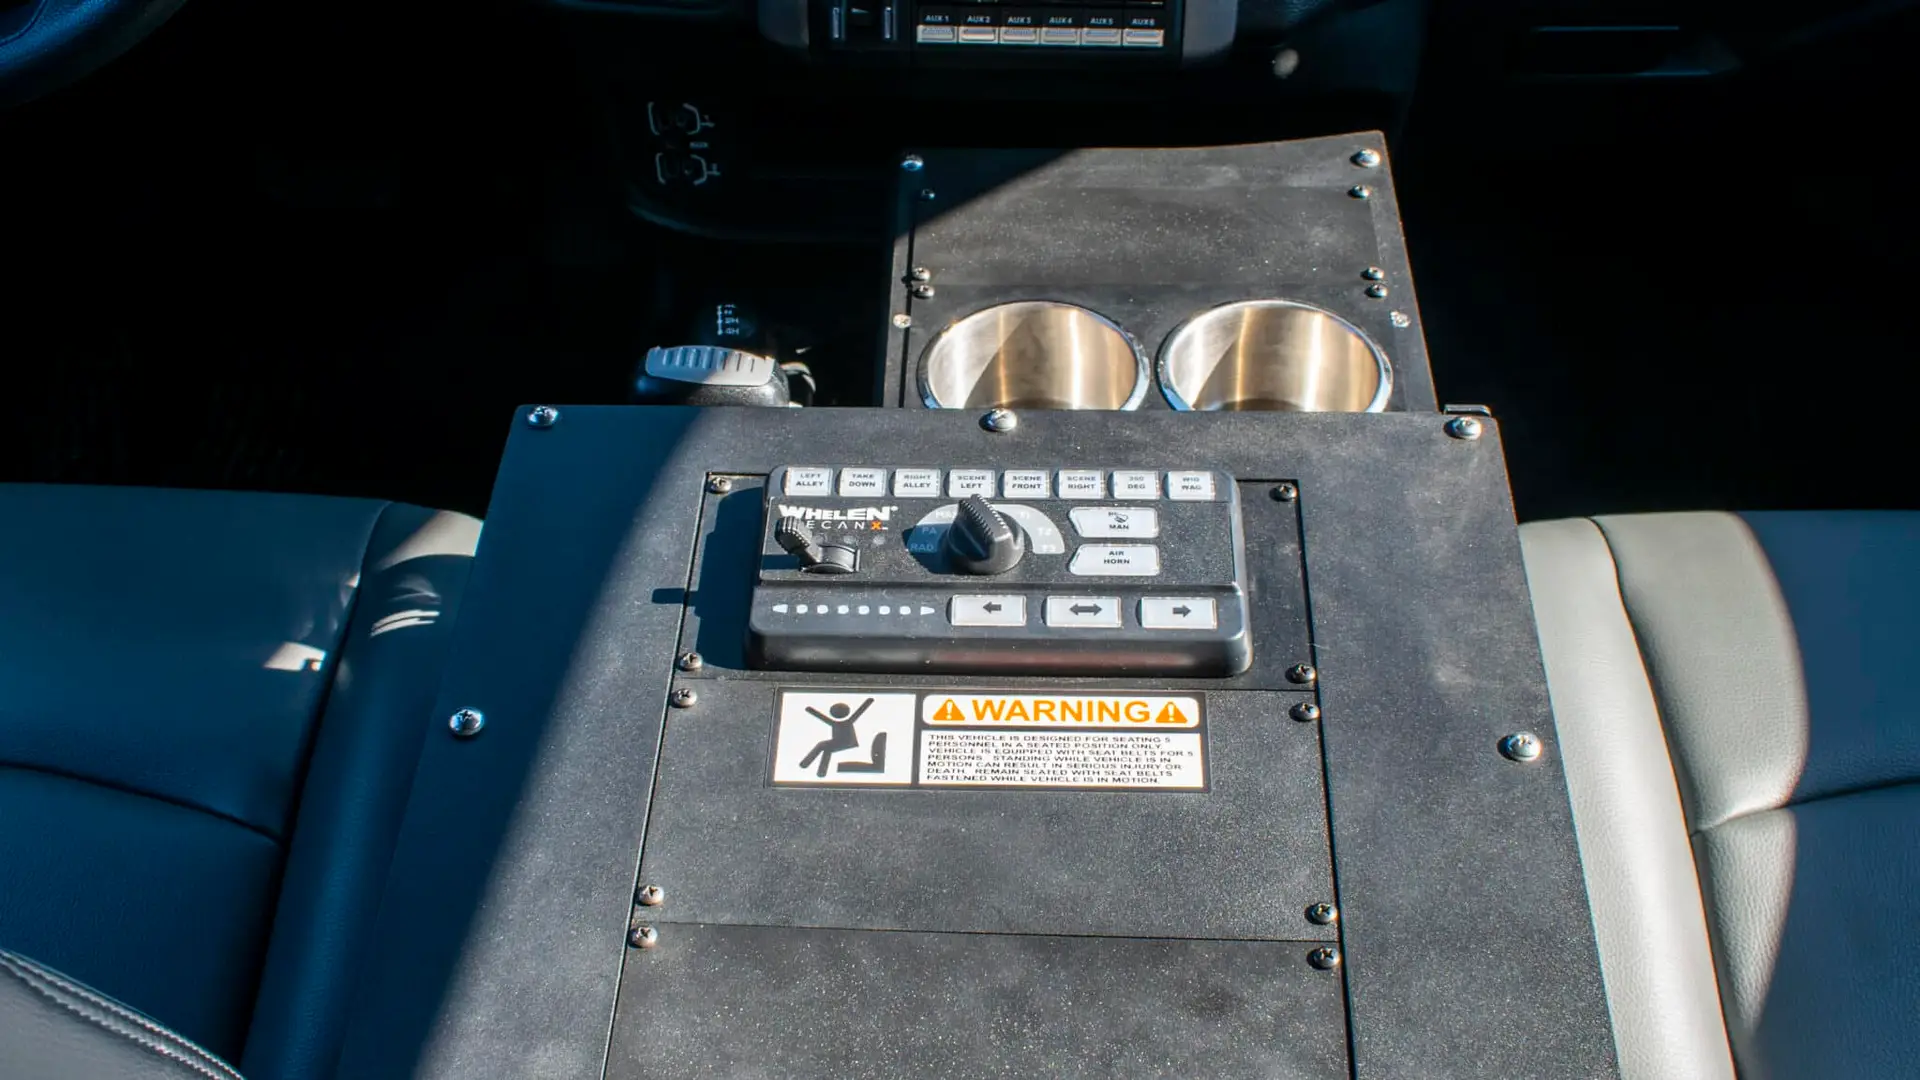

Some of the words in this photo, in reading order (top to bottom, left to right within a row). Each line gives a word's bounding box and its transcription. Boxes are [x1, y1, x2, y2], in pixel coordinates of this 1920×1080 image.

[925, 14, 943, 22] AUX
[967, 15, 984, 23] AUX
[1007, 16, 1026, 24] AUX
[1090, 17, 1108, 25] AUX
[778, 504, 890, 521] WHELEN
[805, 520, 883, 531] ECANX
[1036, 527, 1052, 536] T2
[910, 544, 934, 552] RAD
[971, 699, 1151, 723] WARNING
